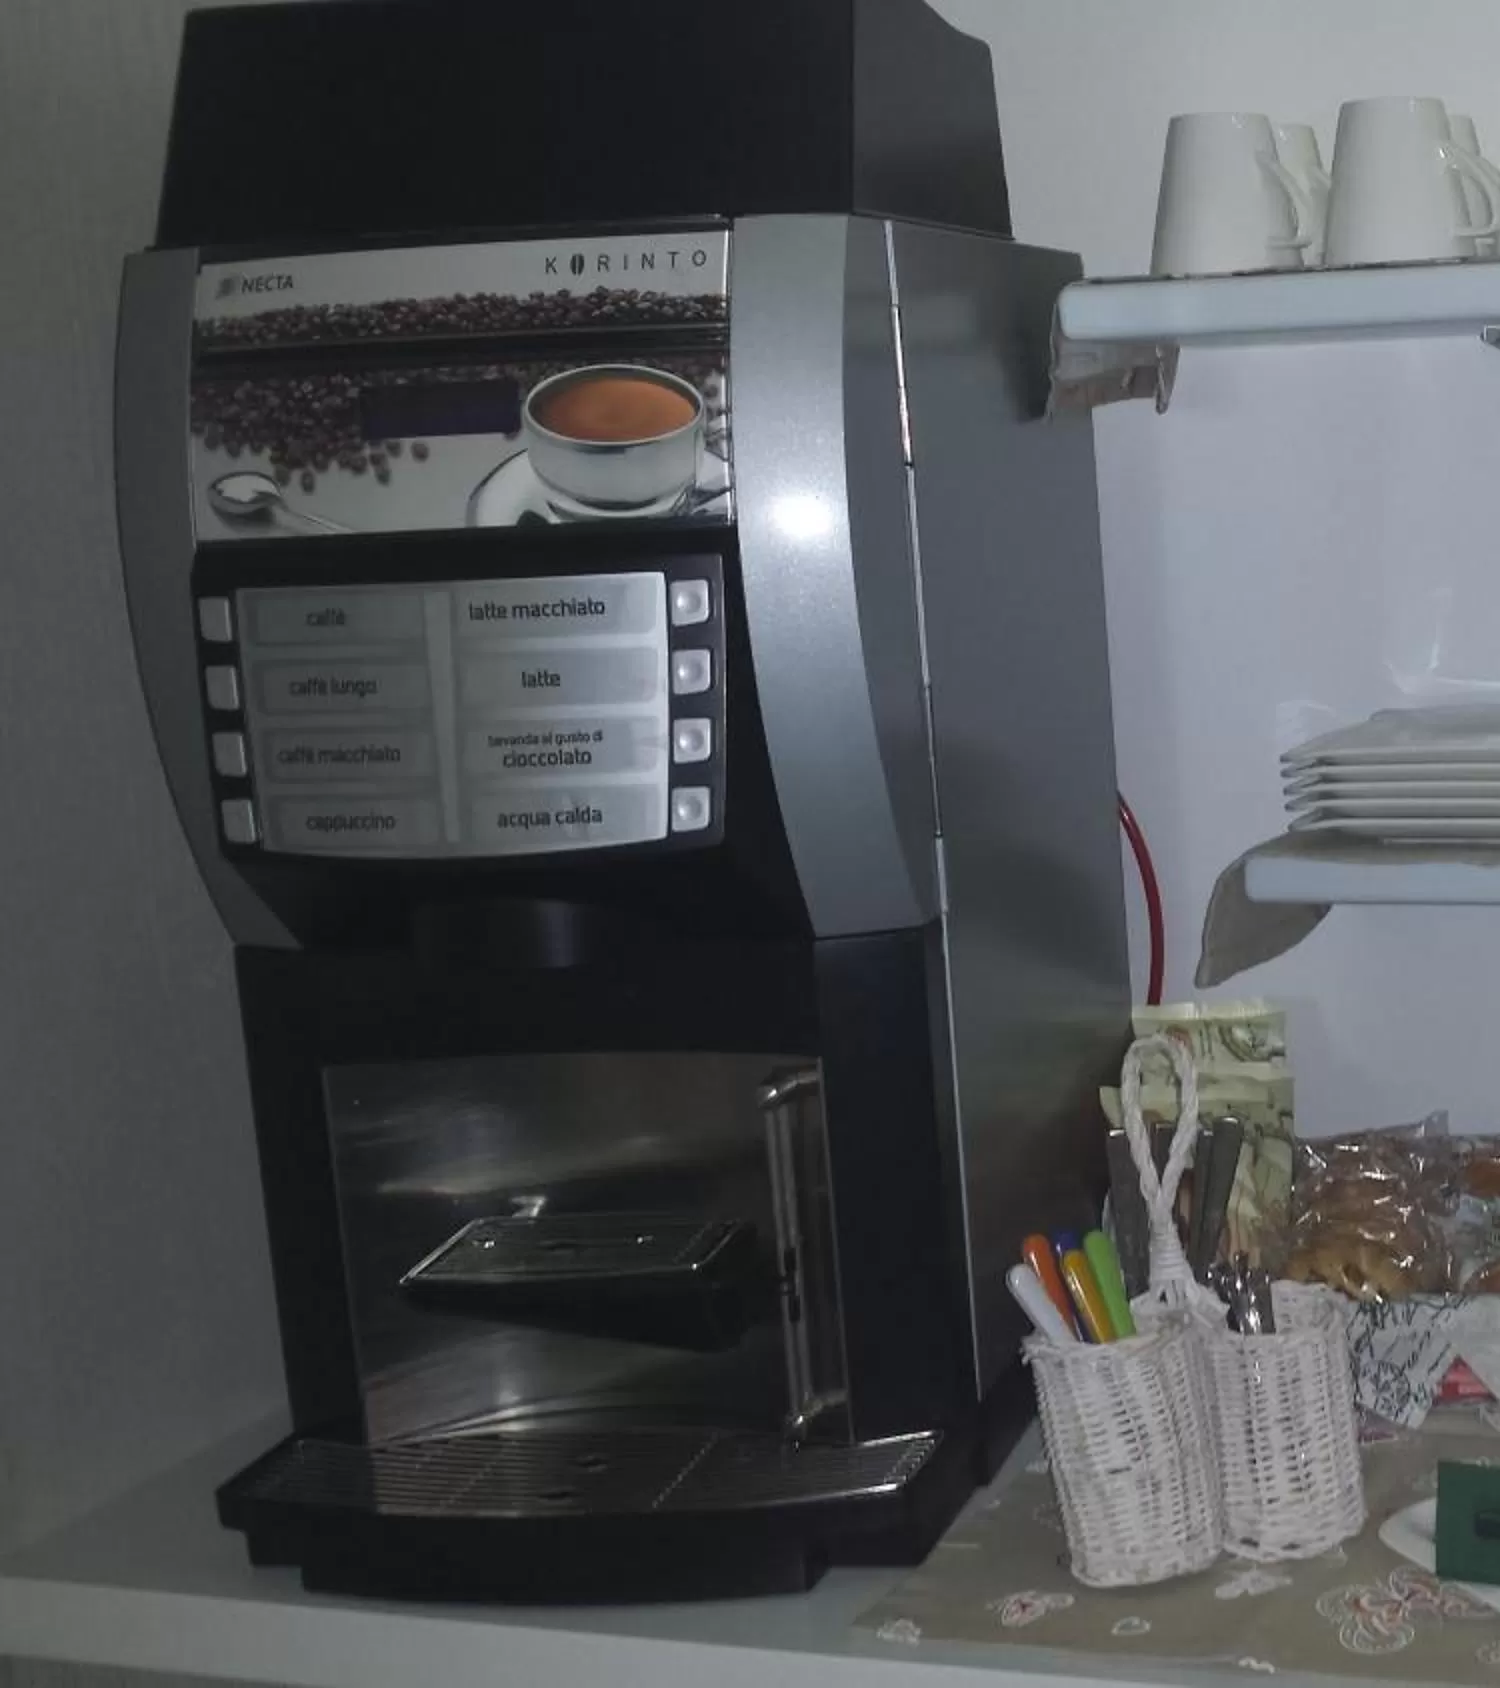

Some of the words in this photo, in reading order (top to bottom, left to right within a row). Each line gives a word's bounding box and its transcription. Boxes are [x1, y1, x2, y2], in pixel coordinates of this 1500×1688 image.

[240, 274, 294, 294] NECTA
[468, 602, 508, 620] latte
[511, 597, 606, 618] macchiato
[330, 677, 378, 699] lungo
[521, 670, 561, 688] latte
[502, 749, 593, 769] cioccolato
[304, 808, 396, 833] cappuccino
[497, 810, 551, 830] acqua
[554, 805, 603, 824] calda
